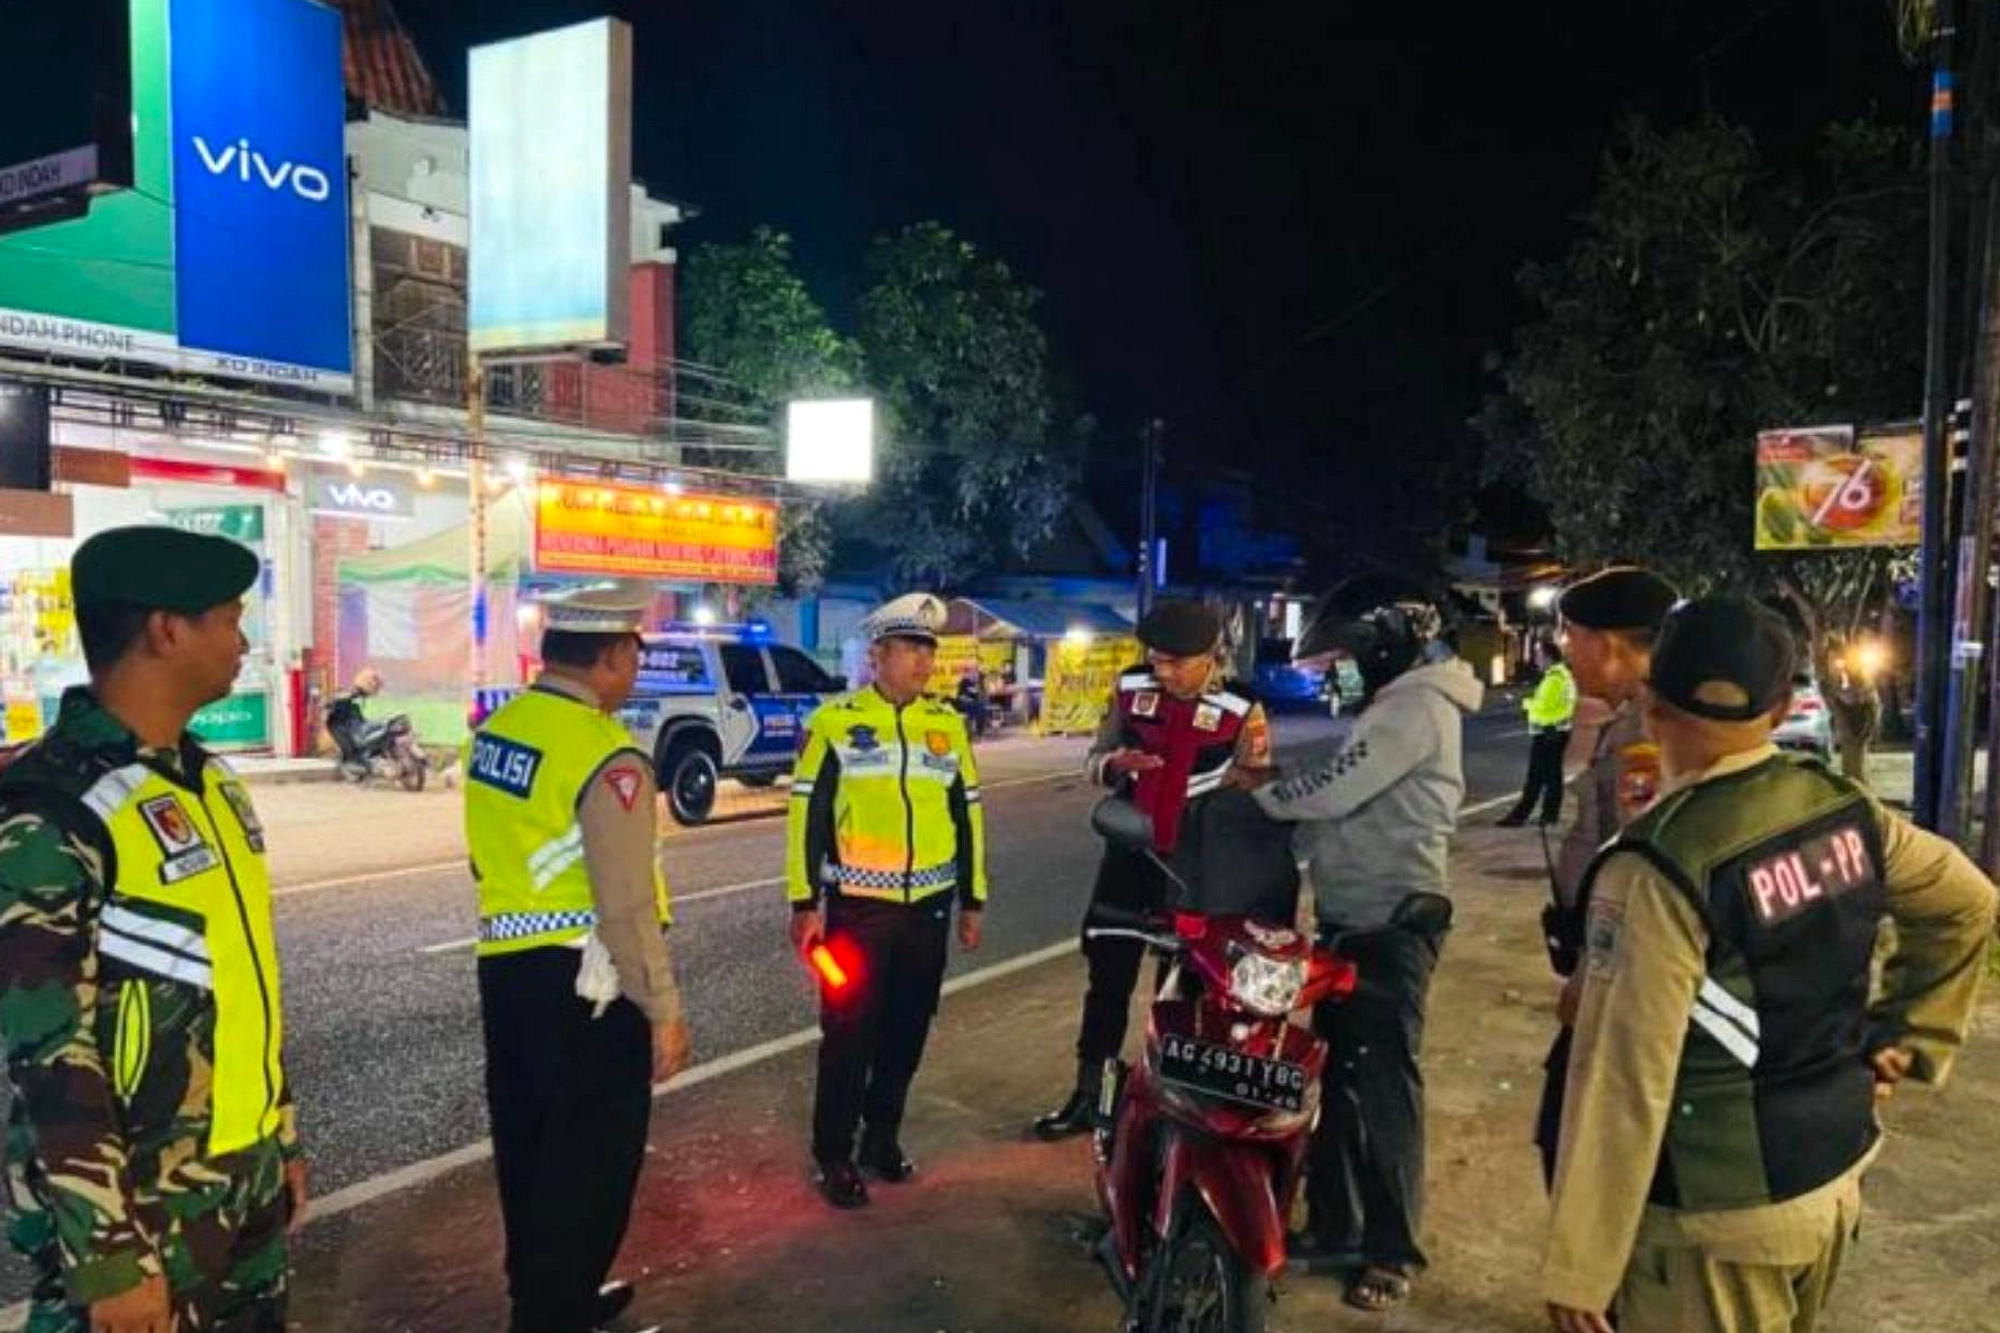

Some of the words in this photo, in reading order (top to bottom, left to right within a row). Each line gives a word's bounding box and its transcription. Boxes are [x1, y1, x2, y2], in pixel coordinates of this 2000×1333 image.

[192, 136, 330, 201] vivo
[61, 324, 133, 350] PHONE
[328, 483, 395, 510] vivo
[473, 737, 535, 788] POLISI
